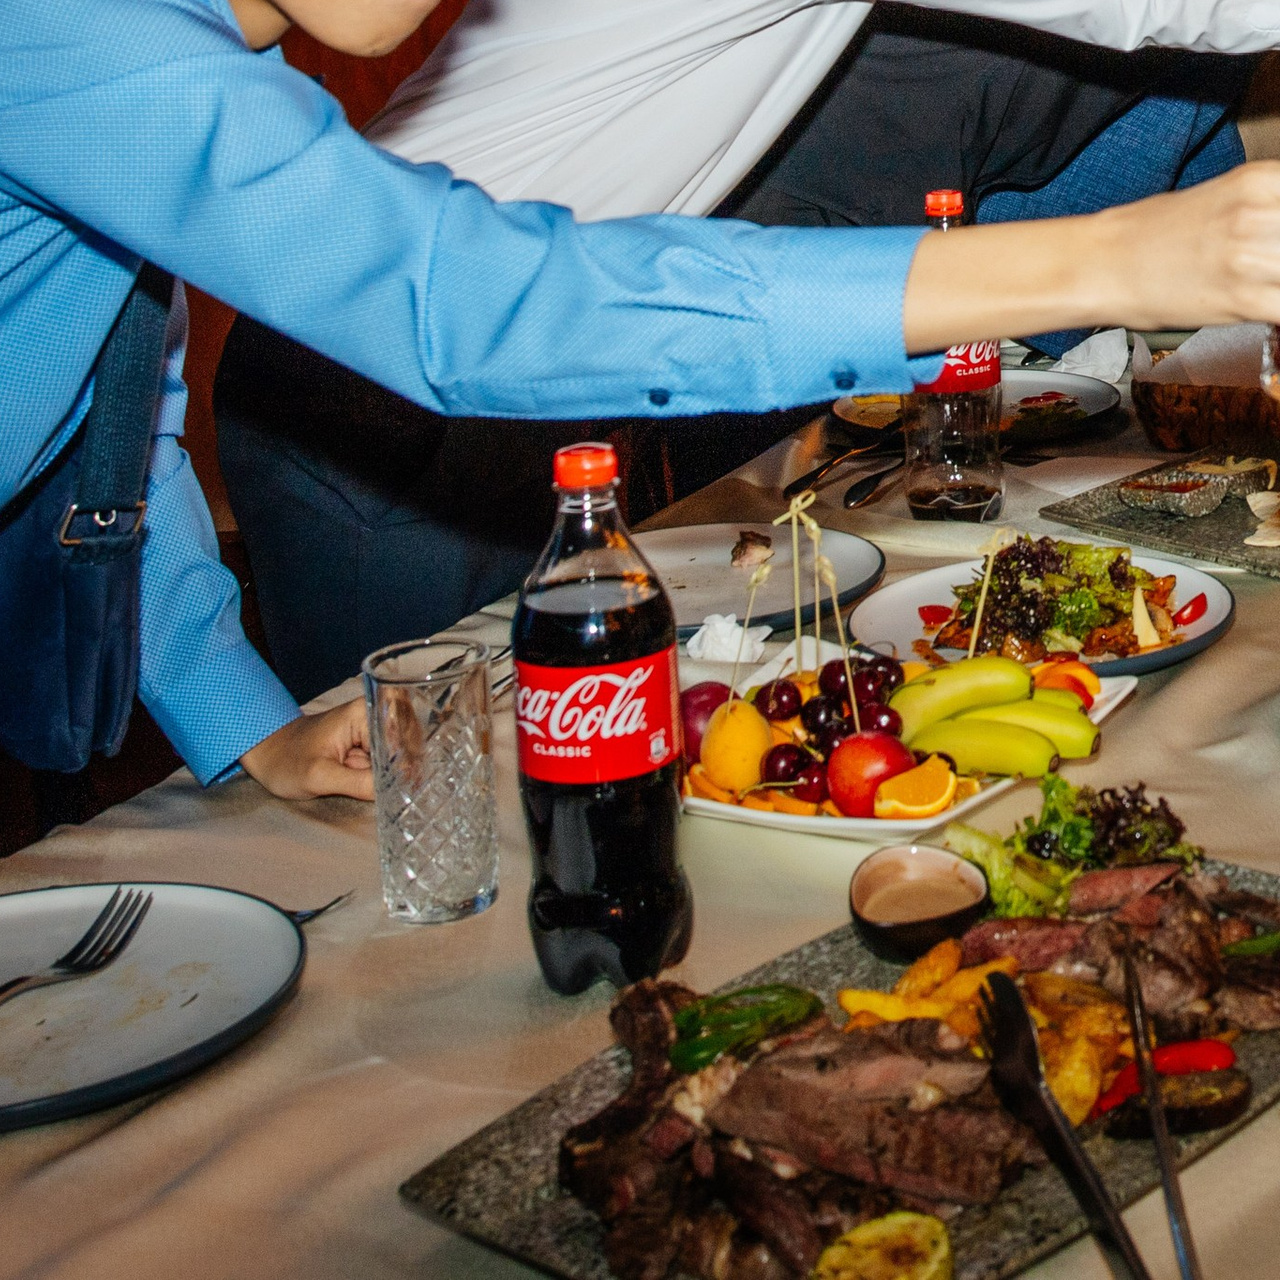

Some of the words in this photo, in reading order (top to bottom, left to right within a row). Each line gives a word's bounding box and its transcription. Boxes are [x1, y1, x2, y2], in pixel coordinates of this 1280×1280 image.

[956, 364, 991, 377] CLASSIC
[517, 664, 655, 741] ca-Cola
[532, 742, 592, 758] CLASSIC
